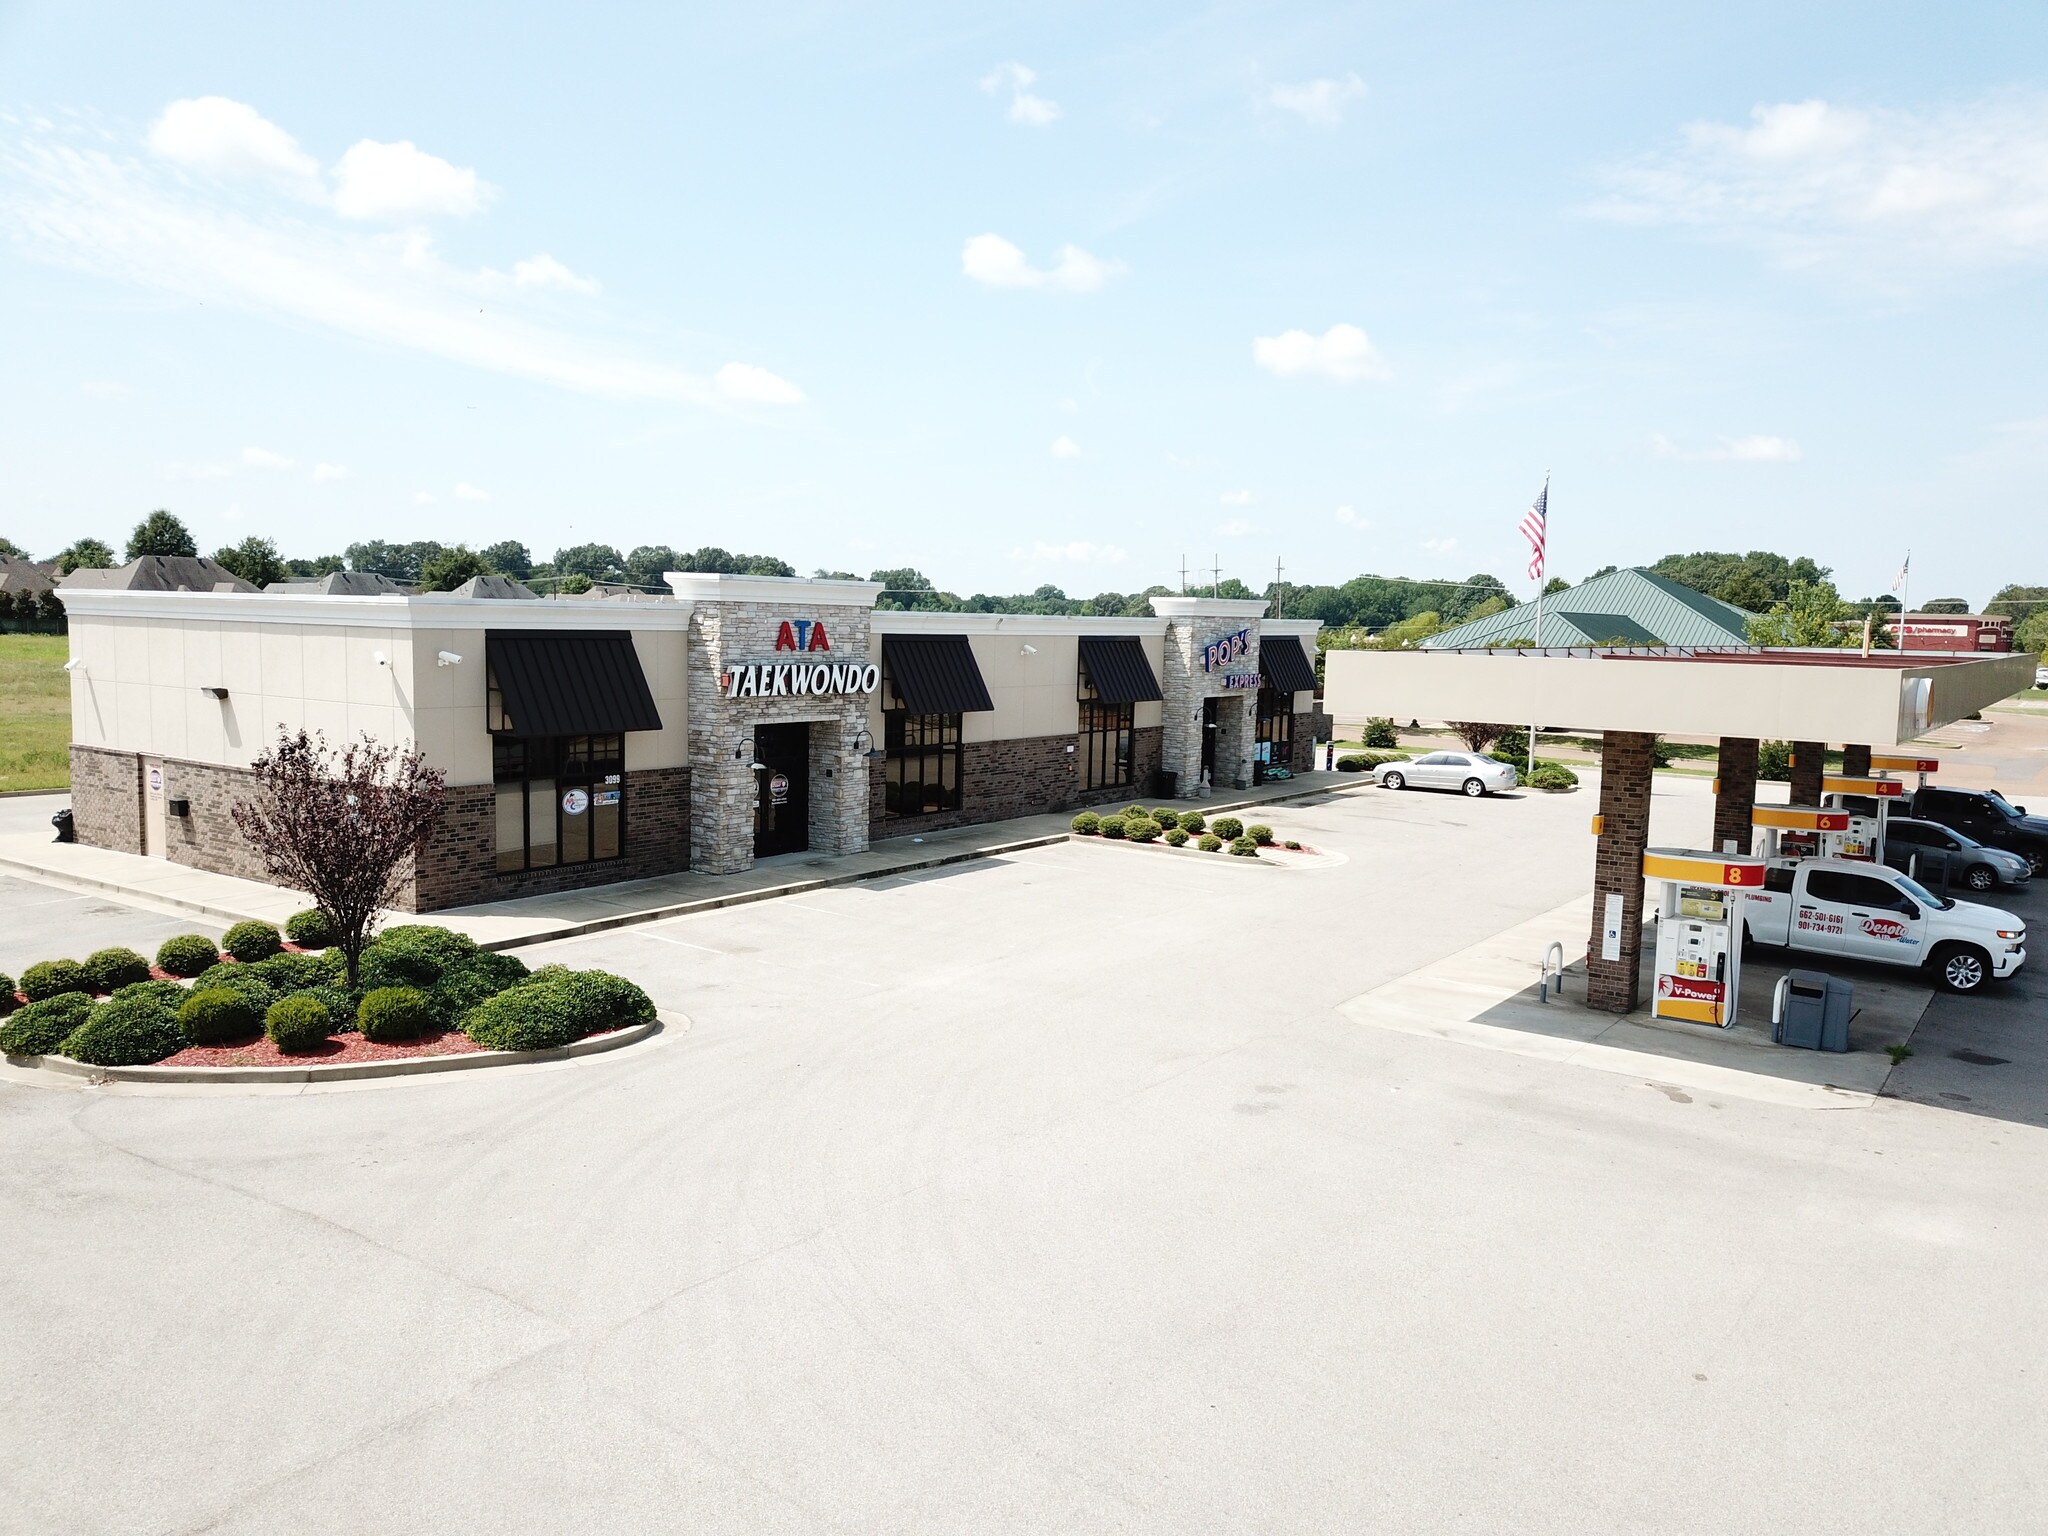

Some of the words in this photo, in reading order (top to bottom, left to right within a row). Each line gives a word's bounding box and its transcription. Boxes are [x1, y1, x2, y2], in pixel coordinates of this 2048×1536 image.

[775, 620, 830, 652] ATA
[1205, 629, 1251, 672] POP'S
[726, 664, 880, 697] TAEKWONDO
[1227, 674, 1261, 688] EXPRESS
[1920, 762, 1927, 770] 2
[605, 775, 620, 784] 3099
[1879, 784, 1888, 793] 4
[1820, 817, 1831, 829] 6
[1729, 868, 1741, 884] 8
[1745, 893, 1772, 903] PLUMBING
[1799, 910, 1844, 924] 662-501-6161
[1798, 920, 1843, 935] 901-734-9721
[1858, 918, 1909, 936] Desoto
[1674, 986, 1717, 1000] V-Power
